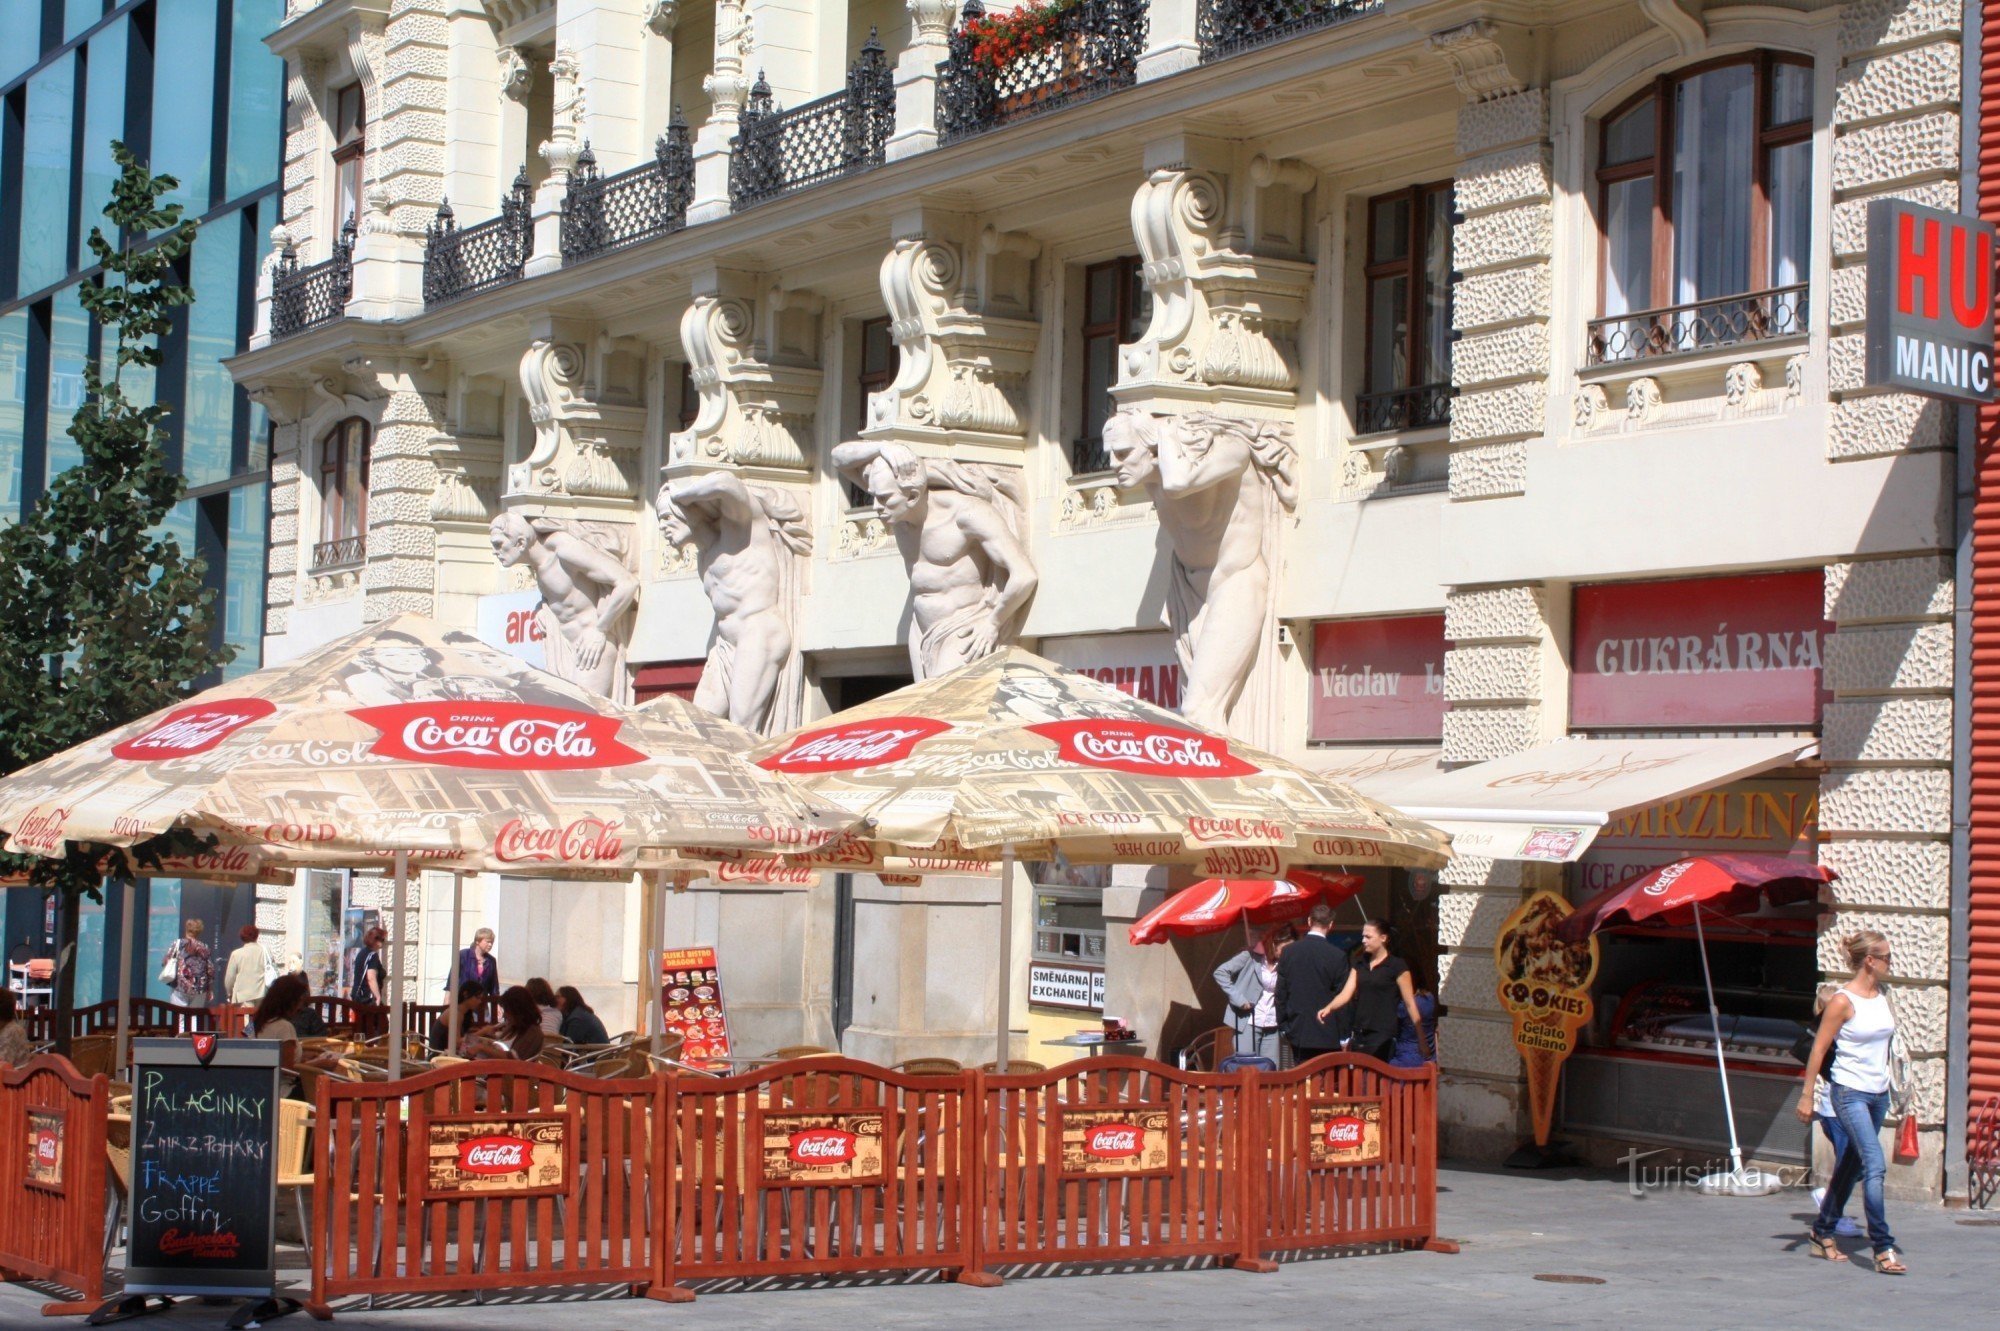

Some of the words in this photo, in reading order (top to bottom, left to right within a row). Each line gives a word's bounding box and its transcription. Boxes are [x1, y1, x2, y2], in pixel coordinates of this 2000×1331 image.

[1897, 211, 1991, 329] HU
[1896, 336, 1989, 393] MANIC
[1595, 622, 1823, 677] CUKRÁRNA
[1319, 664, 1401, 698] Václav
[402, 716, 597, 757] Coca-Cola
[1073, 731, 1222, 769] Coca-Cola
[1056, 812, 1085, 826] ICE
[1088, 812, 1143, 825] COLD
[263, 823, 337, 843] COLD
[494, 818, 625, 863] Coca-Cola
[746, 825, 802, 844] SOLD
[908, 856, 950, 870] SOLD
[954, 860, 993, 873] HERE
[1033, 971, 1089, 987] SMĚNÁRNA
[1032, 985, 1088, 1001] EXCHANGE
[1522, 1020, 1565, 1040] Gelato
[1517, 1032, 1567, 1052] italiano
[797, 1137, 848, 1157] Coca-Cola
[1092, 1131, 1137, 1150] Coca-Cola
[467, 1144, 523, 1167] Coca-Cola
